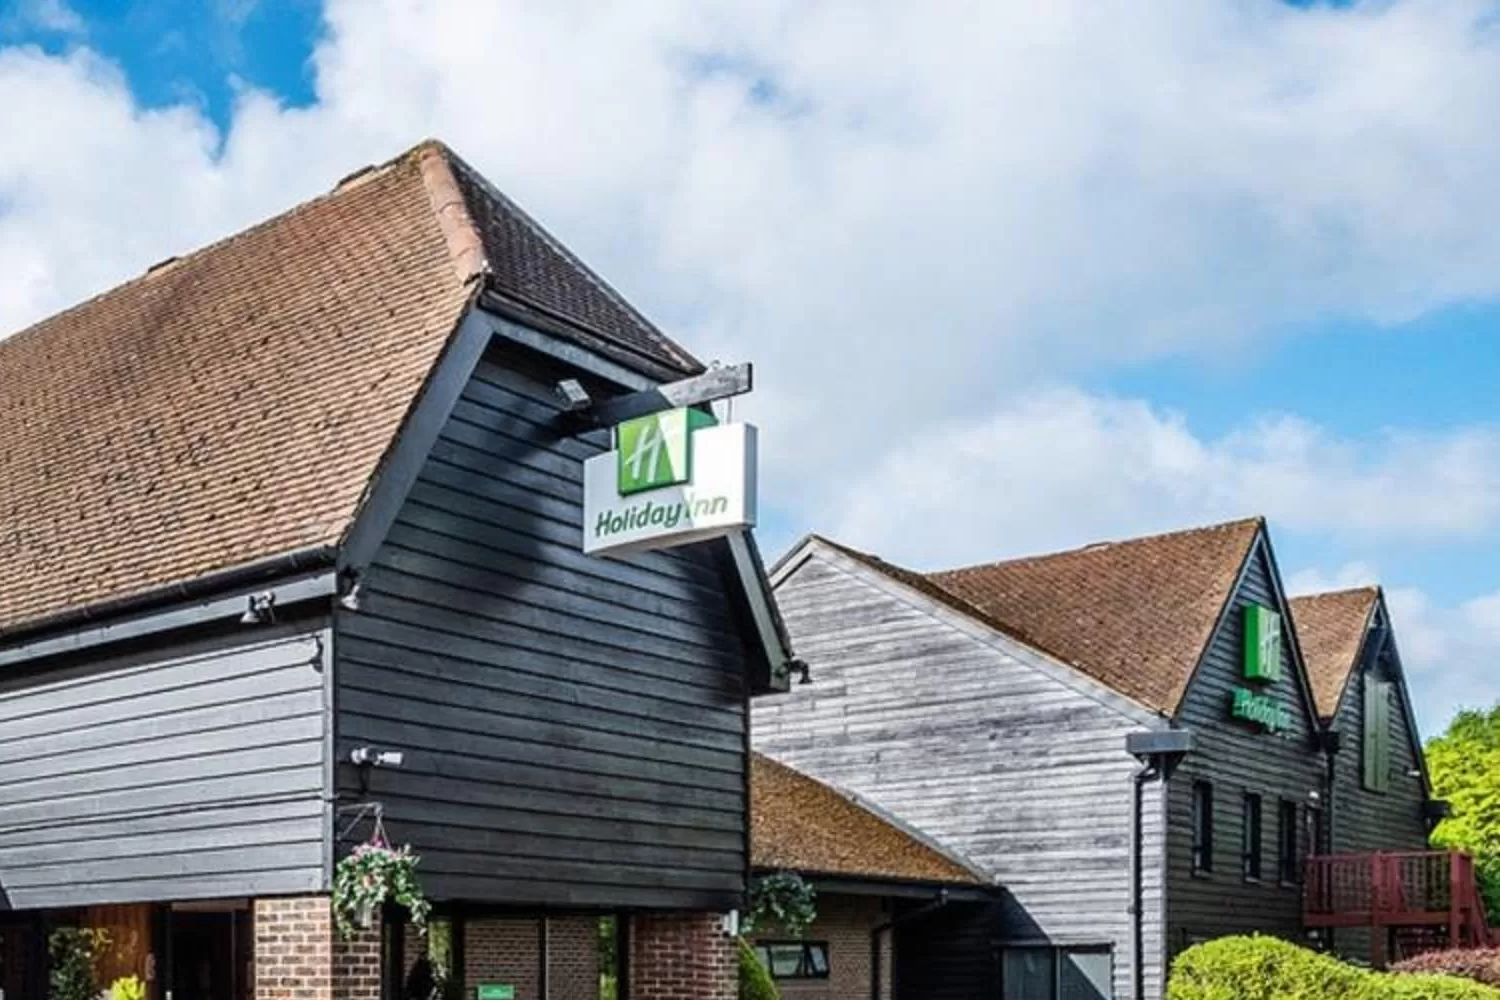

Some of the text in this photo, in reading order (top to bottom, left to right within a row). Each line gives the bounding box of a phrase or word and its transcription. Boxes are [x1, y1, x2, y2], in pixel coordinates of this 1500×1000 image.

[625, 423, 664, 483] H
[595, 492, 728, 538] Holiday Inn
